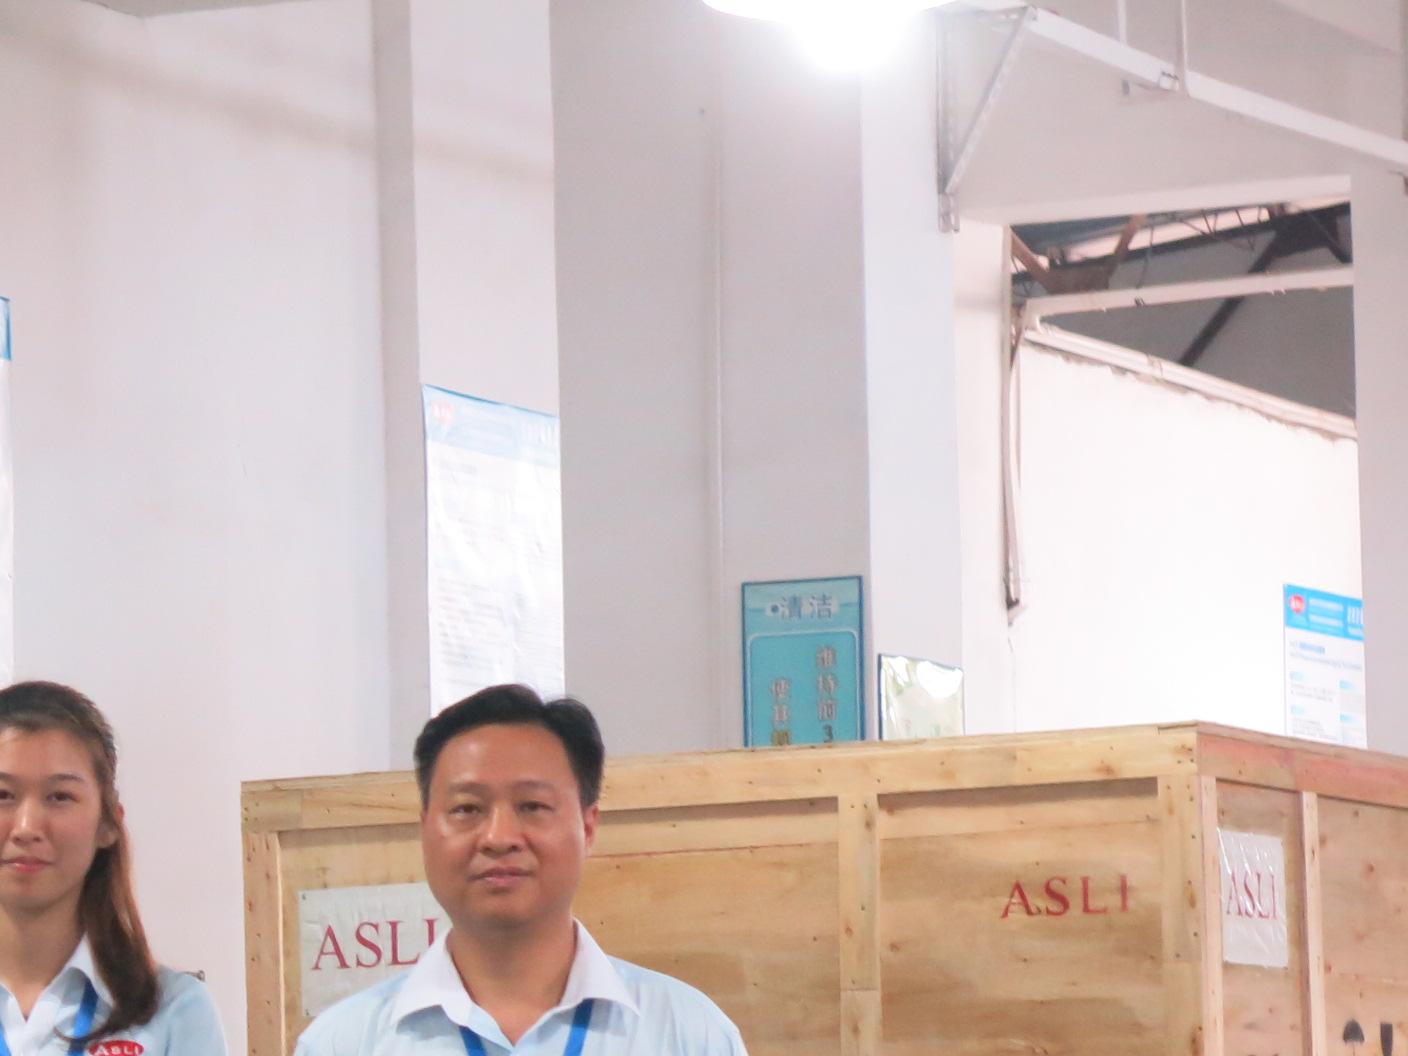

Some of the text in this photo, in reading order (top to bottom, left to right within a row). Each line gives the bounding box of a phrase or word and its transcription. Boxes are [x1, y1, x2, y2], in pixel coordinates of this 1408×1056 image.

[781, 592, 833, 621] 清洁
[1001, 873, 1130, 919] ASLI
[1226, 870, 1278, 919] ASLI
[310, 918, 439, 971] ASLI
[94, 1043, 140, 1056] ASLI
